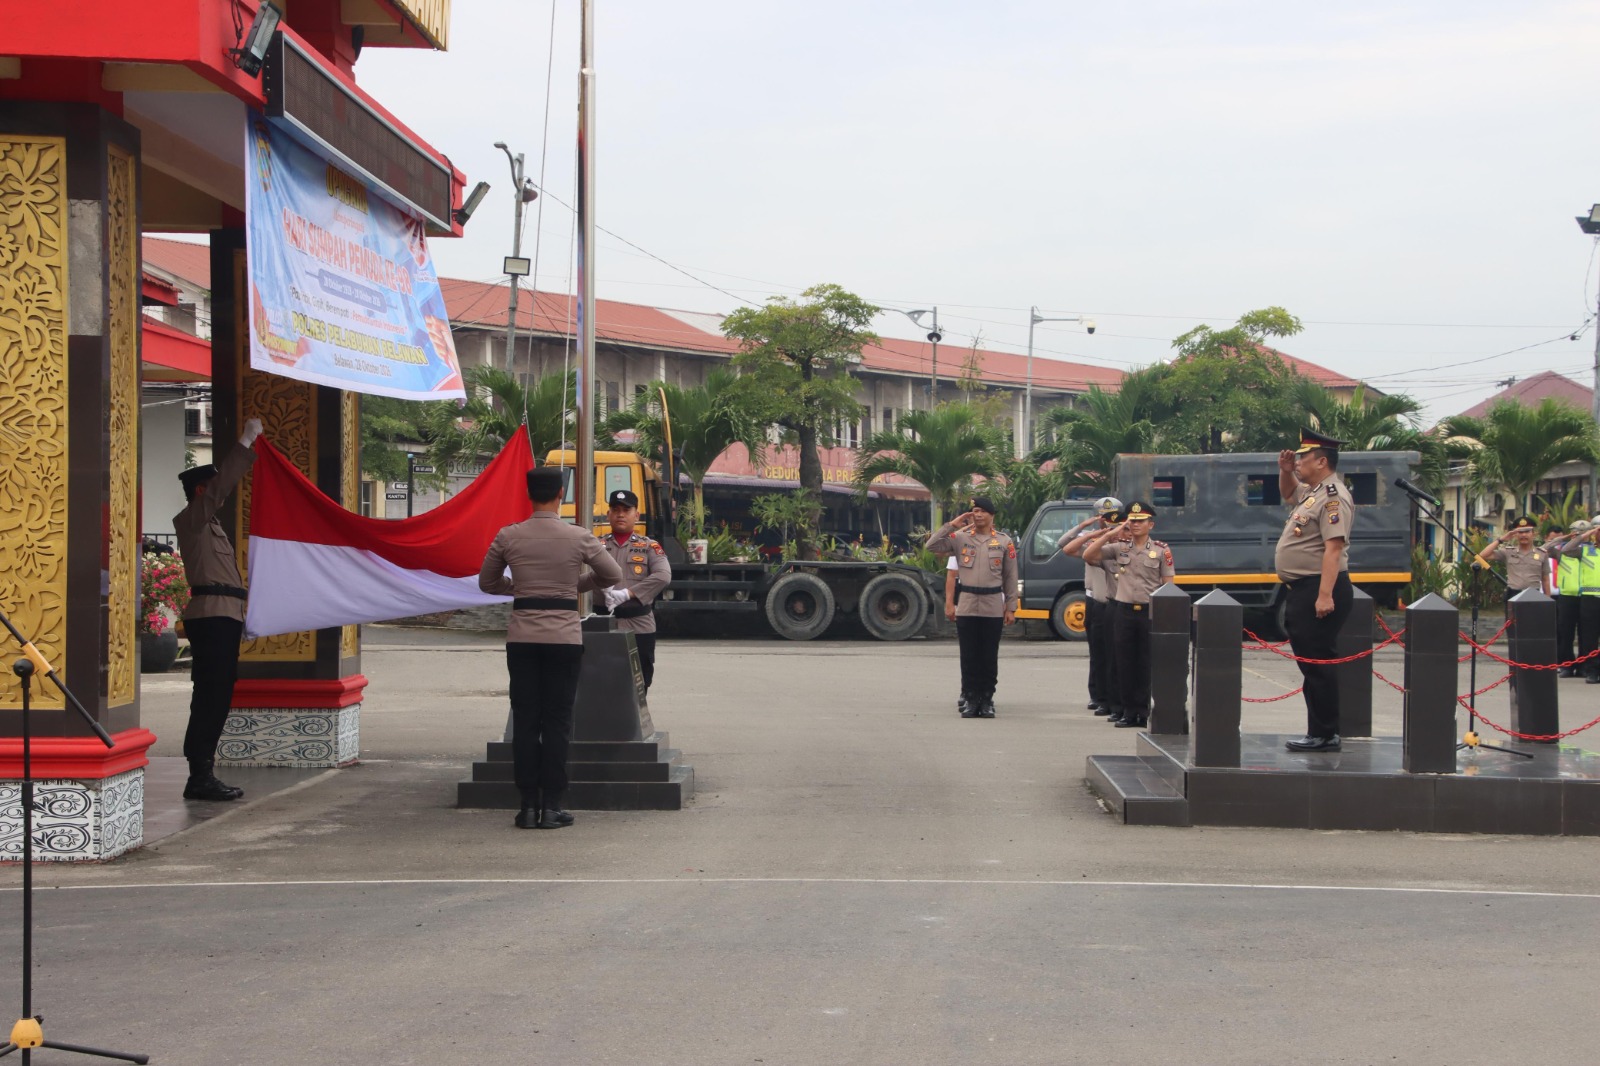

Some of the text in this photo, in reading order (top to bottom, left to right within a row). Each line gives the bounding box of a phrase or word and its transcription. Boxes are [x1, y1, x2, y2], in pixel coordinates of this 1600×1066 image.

[283, 206, 306, 250] HARI
[308, 222, 347, 270] SUMPAH
[348, 241, 384, 286] PEMUDA
[291, 311, 327, 342] POLRES
[327, 323, 381, 357] PELABUHAN
[381, 339, 429, 366] BELAWAN
